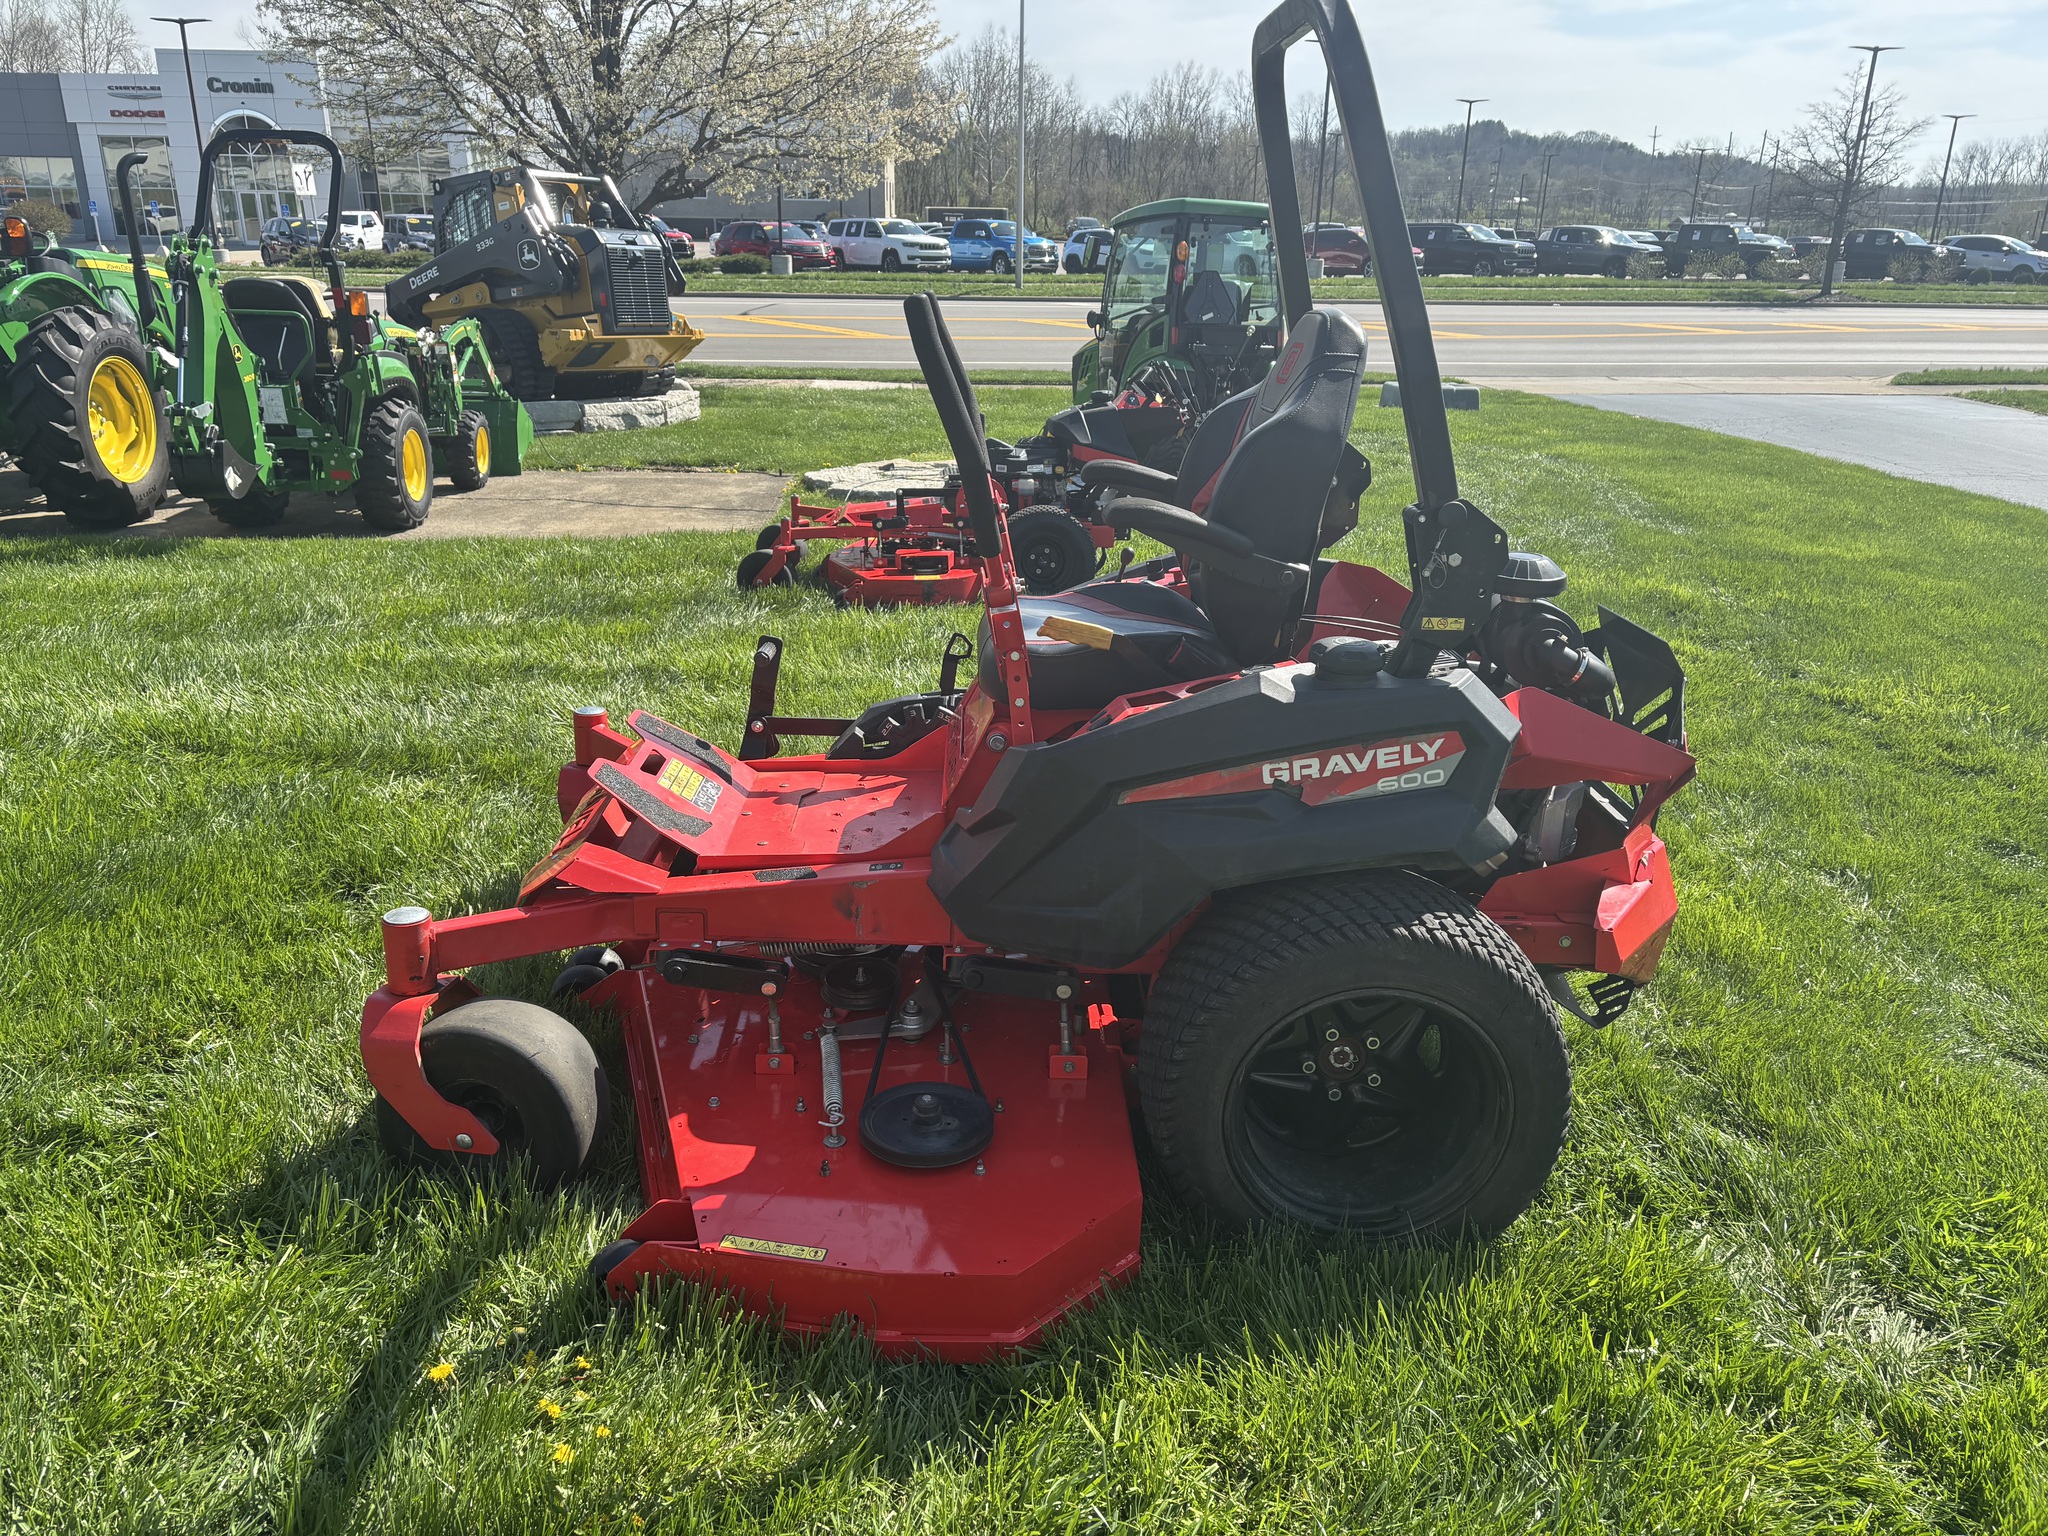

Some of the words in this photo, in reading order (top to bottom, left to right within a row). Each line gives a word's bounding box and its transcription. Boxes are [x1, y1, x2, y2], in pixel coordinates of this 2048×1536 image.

[206, 77, 275, 94] Cronin
[475, 237, 494, 252] 333G
[409, 266, 439, 290] DEERE
[1262, 738, 1445, 785] GRAVELY
[1377, 769, 1445, 791] 600
